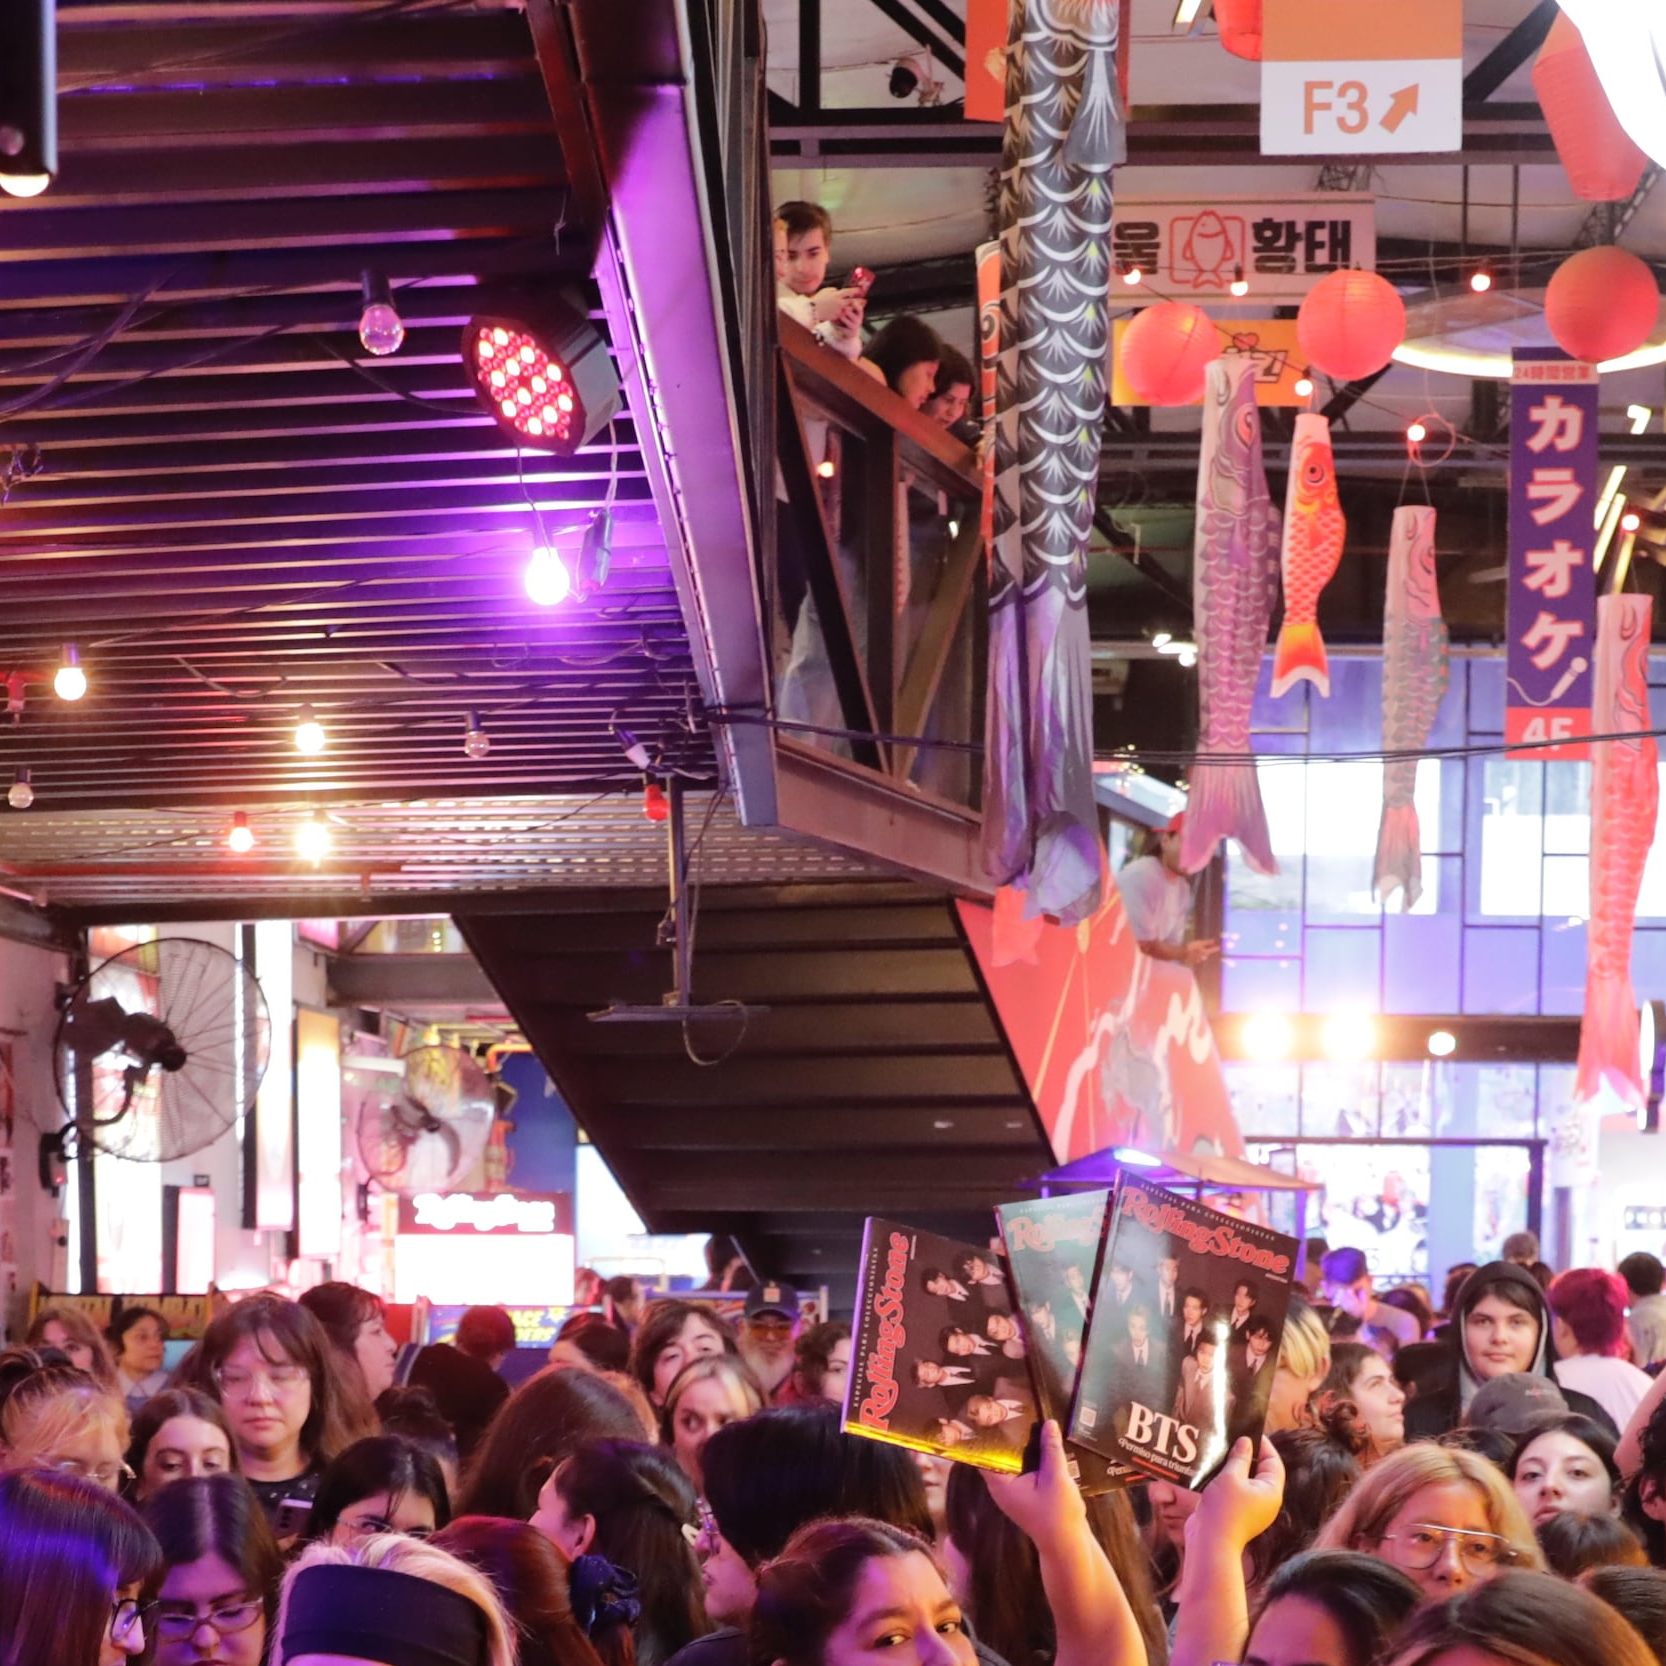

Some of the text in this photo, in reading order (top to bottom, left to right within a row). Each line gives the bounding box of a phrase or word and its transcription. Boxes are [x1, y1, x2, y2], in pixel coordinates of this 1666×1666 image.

[1304, 81, 1369, 134] F3
[1252, 218, 1352, 274] 황태
[1513, 359, 1591, 381] 24時間営業
[1520, 393, 1586, 672] カラオケ
[1521, 716, 1574, 751] 4F
[1181, 1200, 1202, 1216] PARA
[1124, 1400, 1200, 1464] BTS
[1149, 1454, 1169, 1468] para
